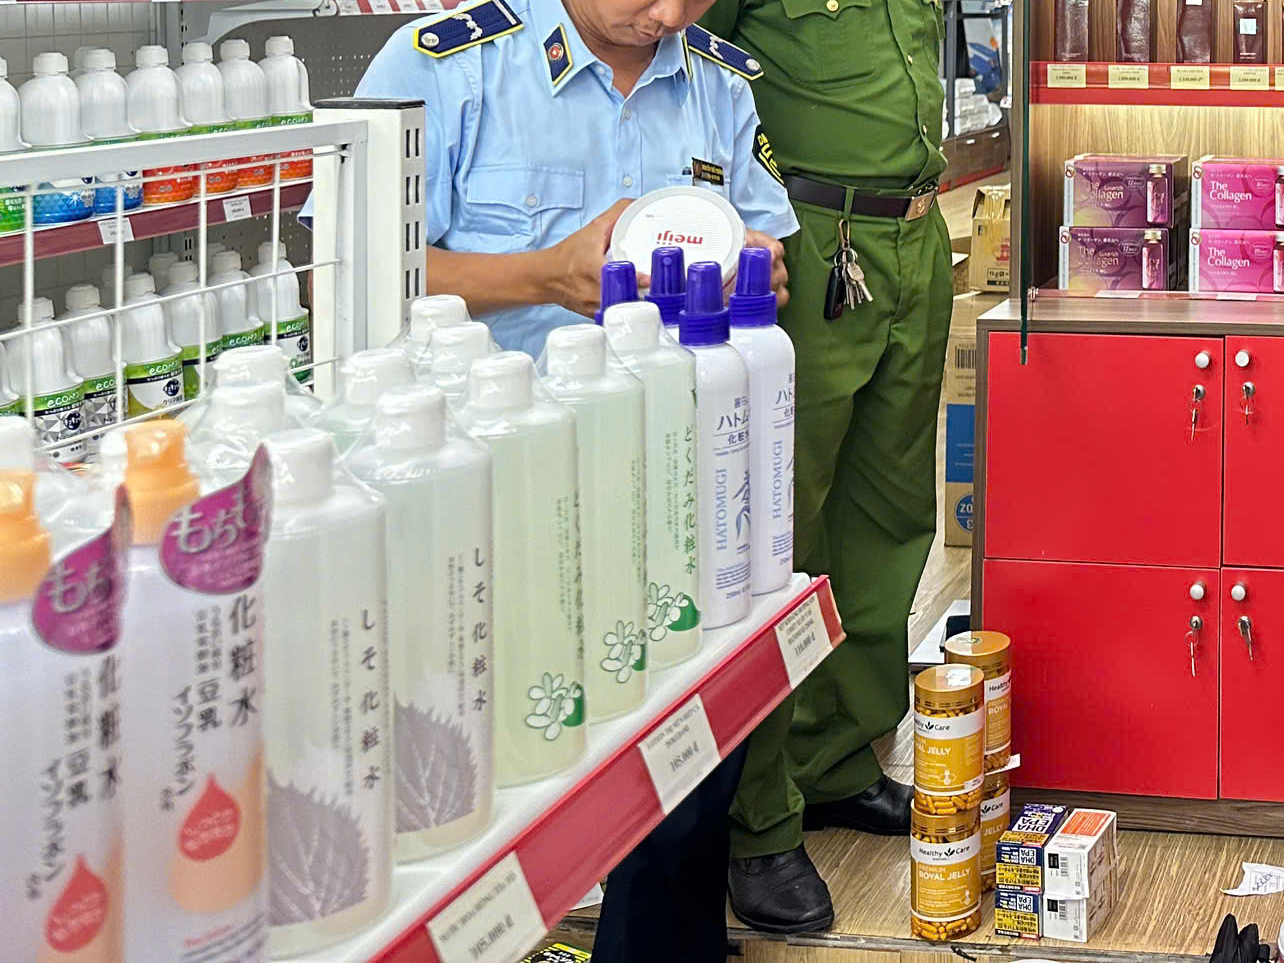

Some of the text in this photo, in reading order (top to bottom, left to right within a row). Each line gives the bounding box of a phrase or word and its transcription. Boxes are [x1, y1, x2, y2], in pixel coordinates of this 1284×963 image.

[1209, 180, 1228, 190] The
[1209, 189, 1252, 203] Collagen
[656, 230, 703, 246] meiji
[1207, 247, 1226, 257] The
[1207, 256, 1250, 269] Collagen
[773, 440, 783, 519] HATOMUGI
[716, 468, 727, 551] HATOMUGI
[471, 547, 489, 713] しそ化粧水
[228, 594, 259, 727] 化粧水
[360, 608, 383, 789] しそ化粧水
[927, 746, 951, 756] JELLY
[991, 802, 1004, 811] Care
[919, 845, 970, 857] Healthy Care
[1020, 848, 1035, 856] EPA
[1020, 855, 1035, 864] DHA
[919, 868, 971, 880] ROYAL JELLY
